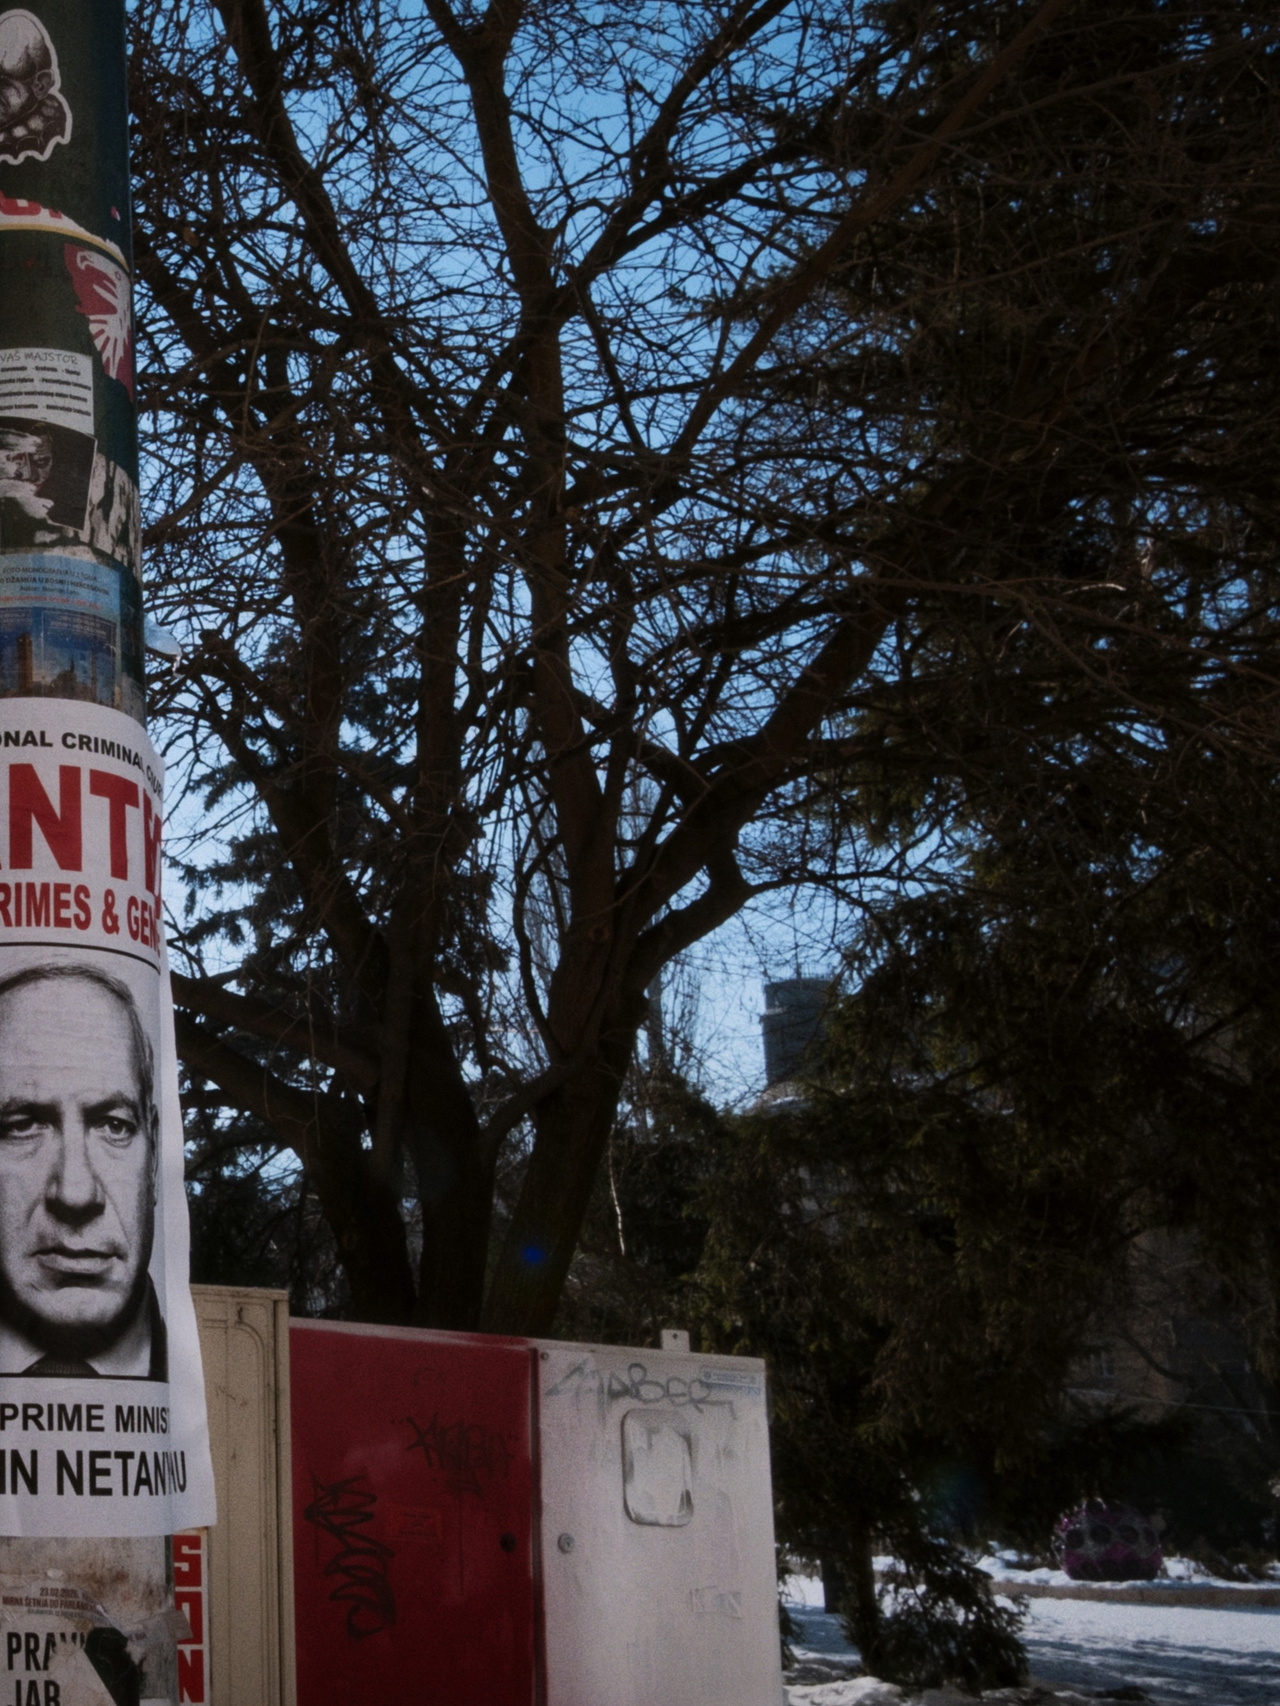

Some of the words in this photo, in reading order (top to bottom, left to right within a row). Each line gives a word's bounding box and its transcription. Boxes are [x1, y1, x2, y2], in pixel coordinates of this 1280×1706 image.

[24, 351, 78, 367] MAJSTOR
[102, 888, 120, 935] &
[0, 1403, 105, 1432] PRIME
